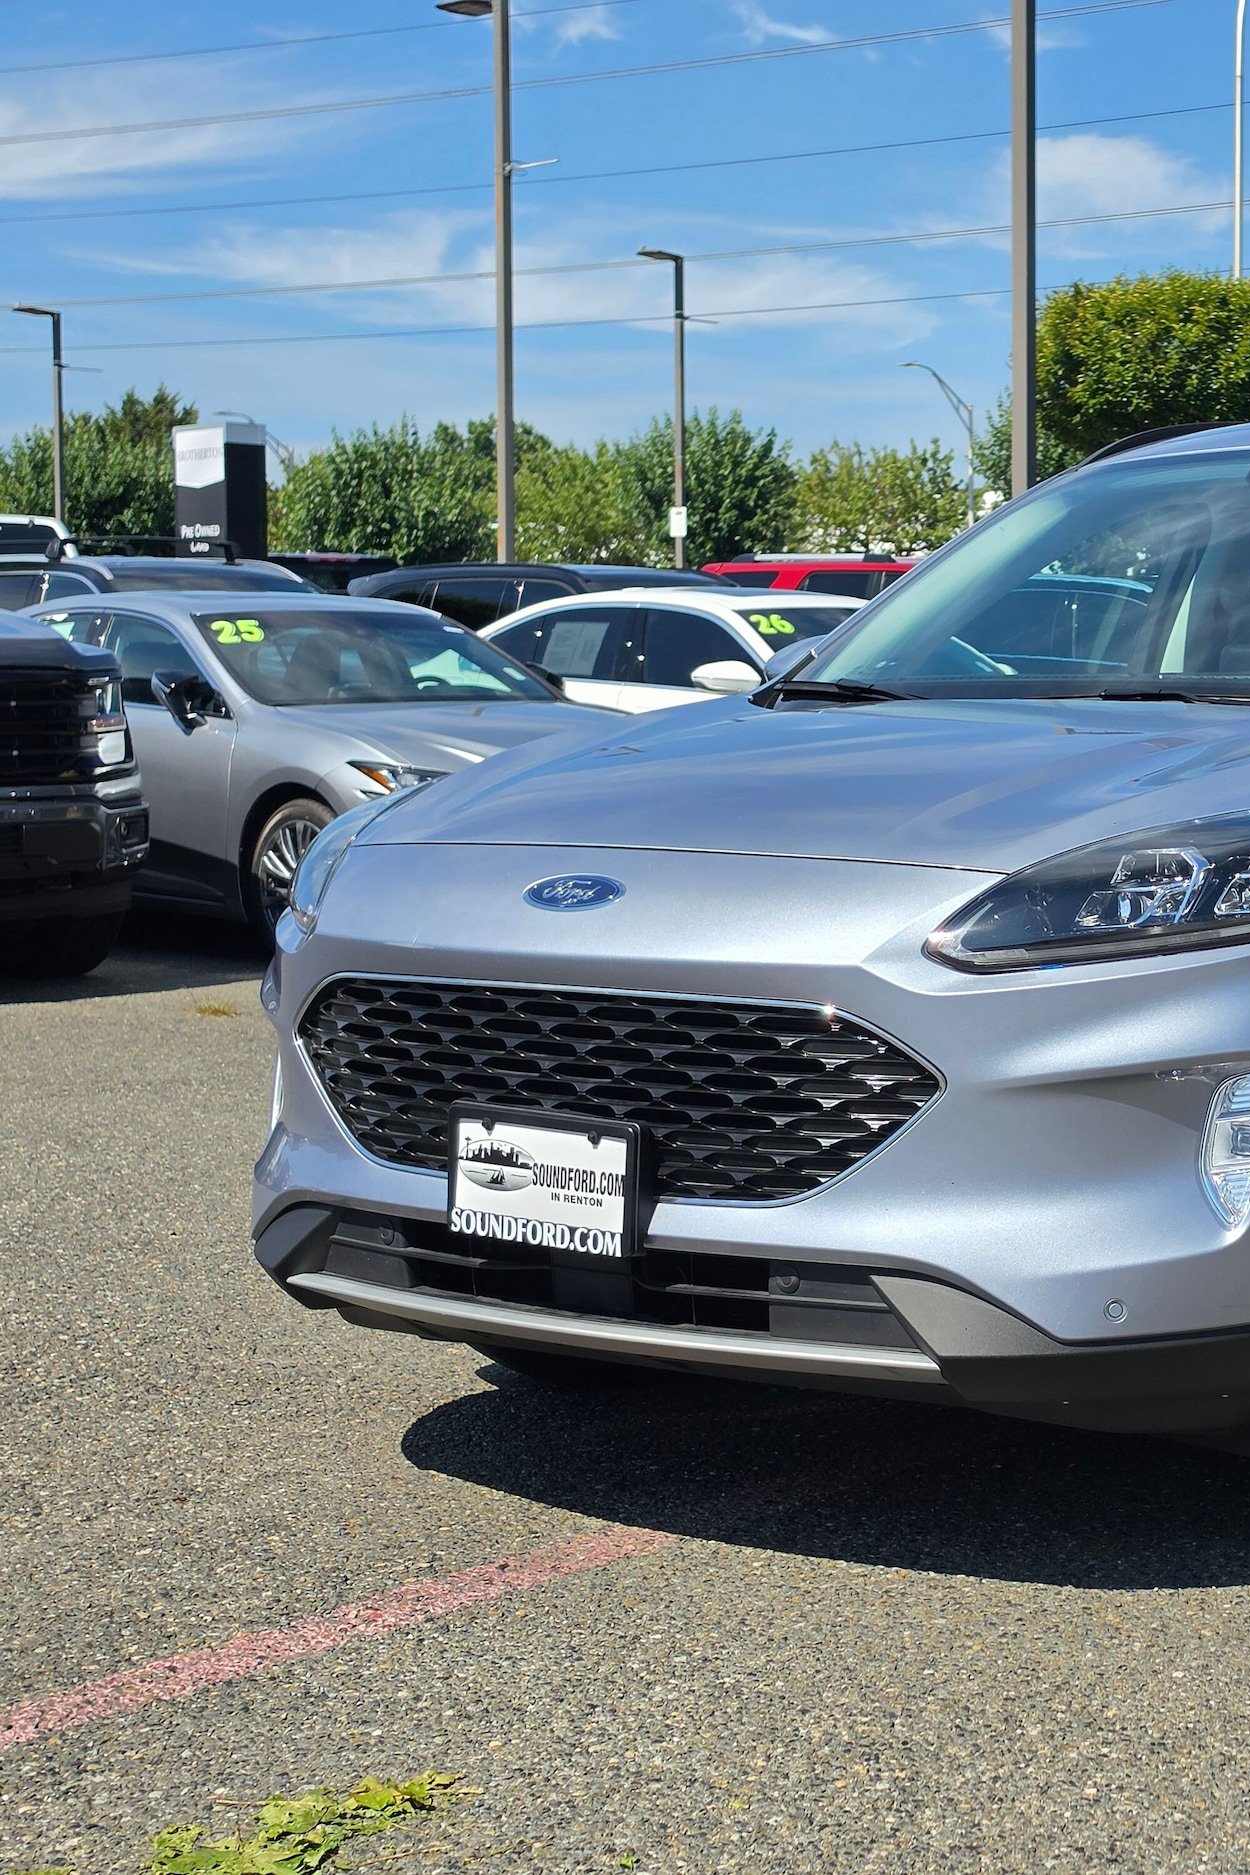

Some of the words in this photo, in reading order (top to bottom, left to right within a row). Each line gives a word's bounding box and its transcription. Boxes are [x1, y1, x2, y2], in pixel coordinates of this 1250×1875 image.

[211, 619, 265, 644] 25
[749, 613, 796, 635] 26
[542, 879, 602, 901] Ford
[532, 1163, 625, 1198] SOUNDFORD.COM
[551, 1192, 561, 1202] IN
[564, 1194, 604, 1208] RENTON
[450, 1206, 622, 1258] SOUNDFORD.COM
